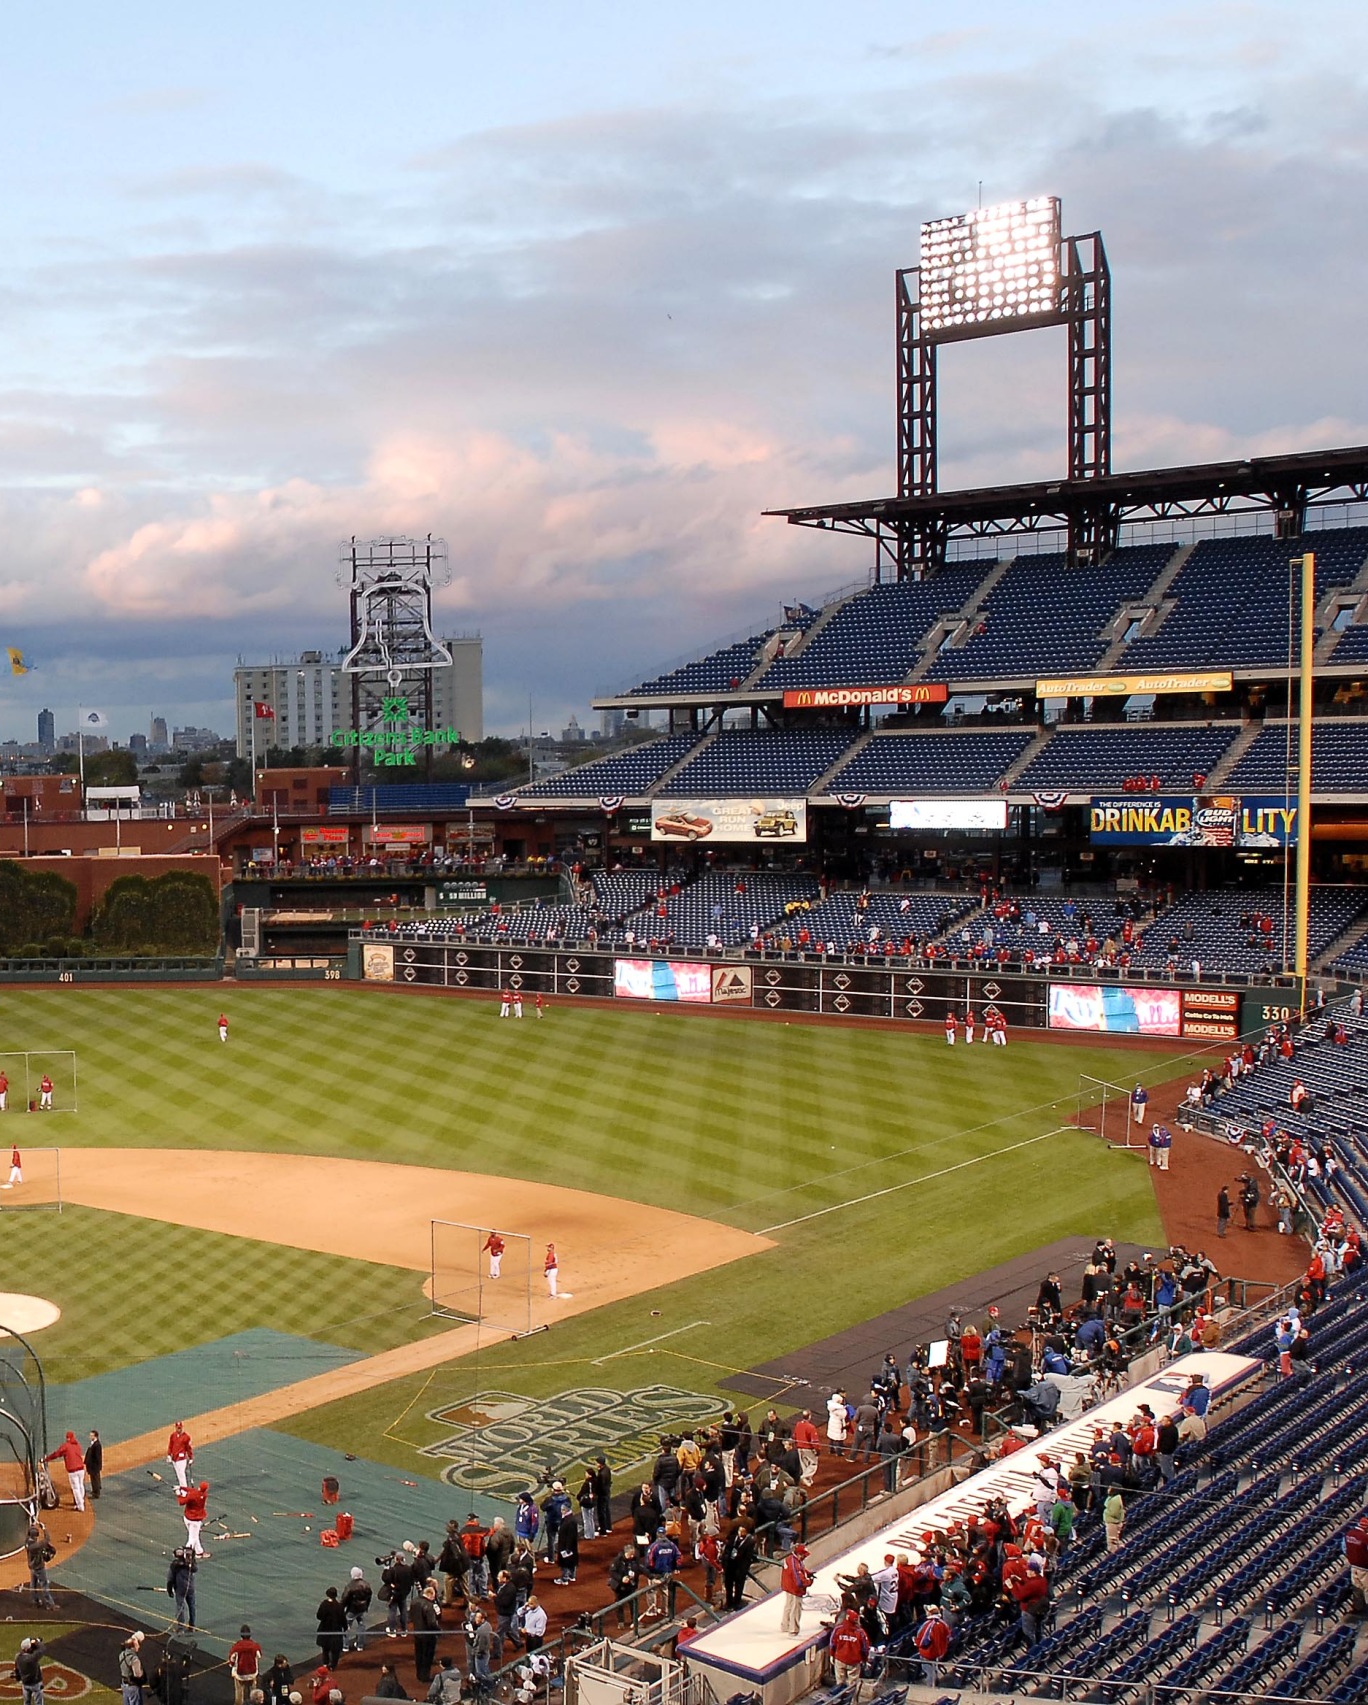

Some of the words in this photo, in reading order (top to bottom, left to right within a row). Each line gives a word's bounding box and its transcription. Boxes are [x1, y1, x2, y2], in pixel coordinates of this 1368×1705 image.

[1037, 681, 1107, 693] AutoTrader
[1135, 678, 1210, 690] AutoTrader
[814, 688, 912, 705] McDonald's
[331, 728, 408, 747] Citizens
[410, 726, 460, 744] Bank
[374, 748, 418, 766] Park
[776, 799, 804, 812] Jeep
[1204, 808, 1232, 817] BUD
[719, 815, 746, 824] RUN
[714, 823, 752, 832] HOME
[58, 972, 73, 982] 401
[324, 969, 341, 980] 398
[1184, 992, 1236, 1005] MODELL'S
[1262, 1005, 1290, 1021] 330
[1184, 1023, 1235, 1036] MODELL'S
[433, 1390, 623, 1460] WORLD
[444, 1386, 729, 1500] SERIES
